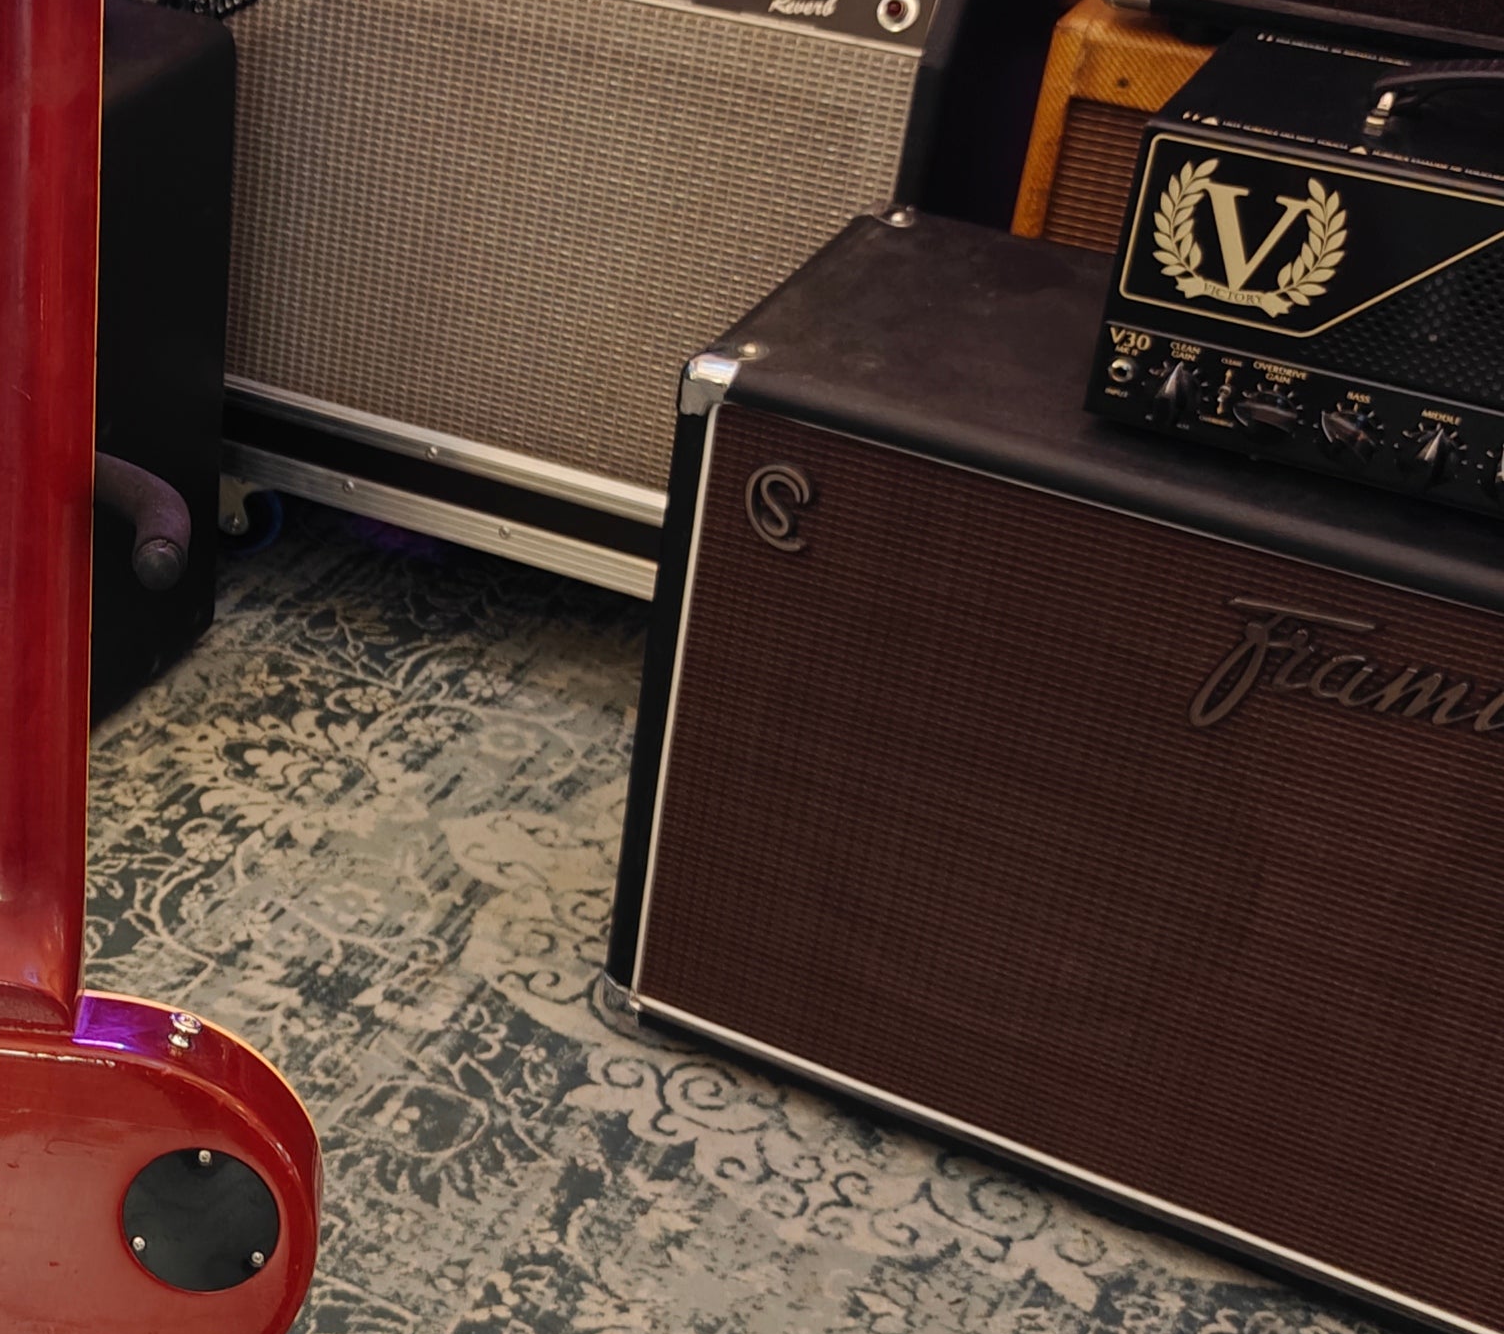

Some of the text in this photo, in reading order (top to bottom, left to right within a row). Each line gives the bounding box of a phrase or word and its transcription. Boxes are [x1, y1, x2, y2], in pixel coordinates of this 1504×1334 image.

[1198, 179, 1312, 295] V
[1202, 280, 1264, 306] VICTORY
[1108, 325, 1152, 352] V30
[1169, 340, 1202, 356] CLEAN
[1170, 349, 1197, 363] GAIN
[1252, 359, 1308, 381] OVERDRIVE
[1264, 372, 1292, 386] GAIN
[1346, 390, 1372, 405] BASS
[1420, 409, 1463, 426] MIDDLE
